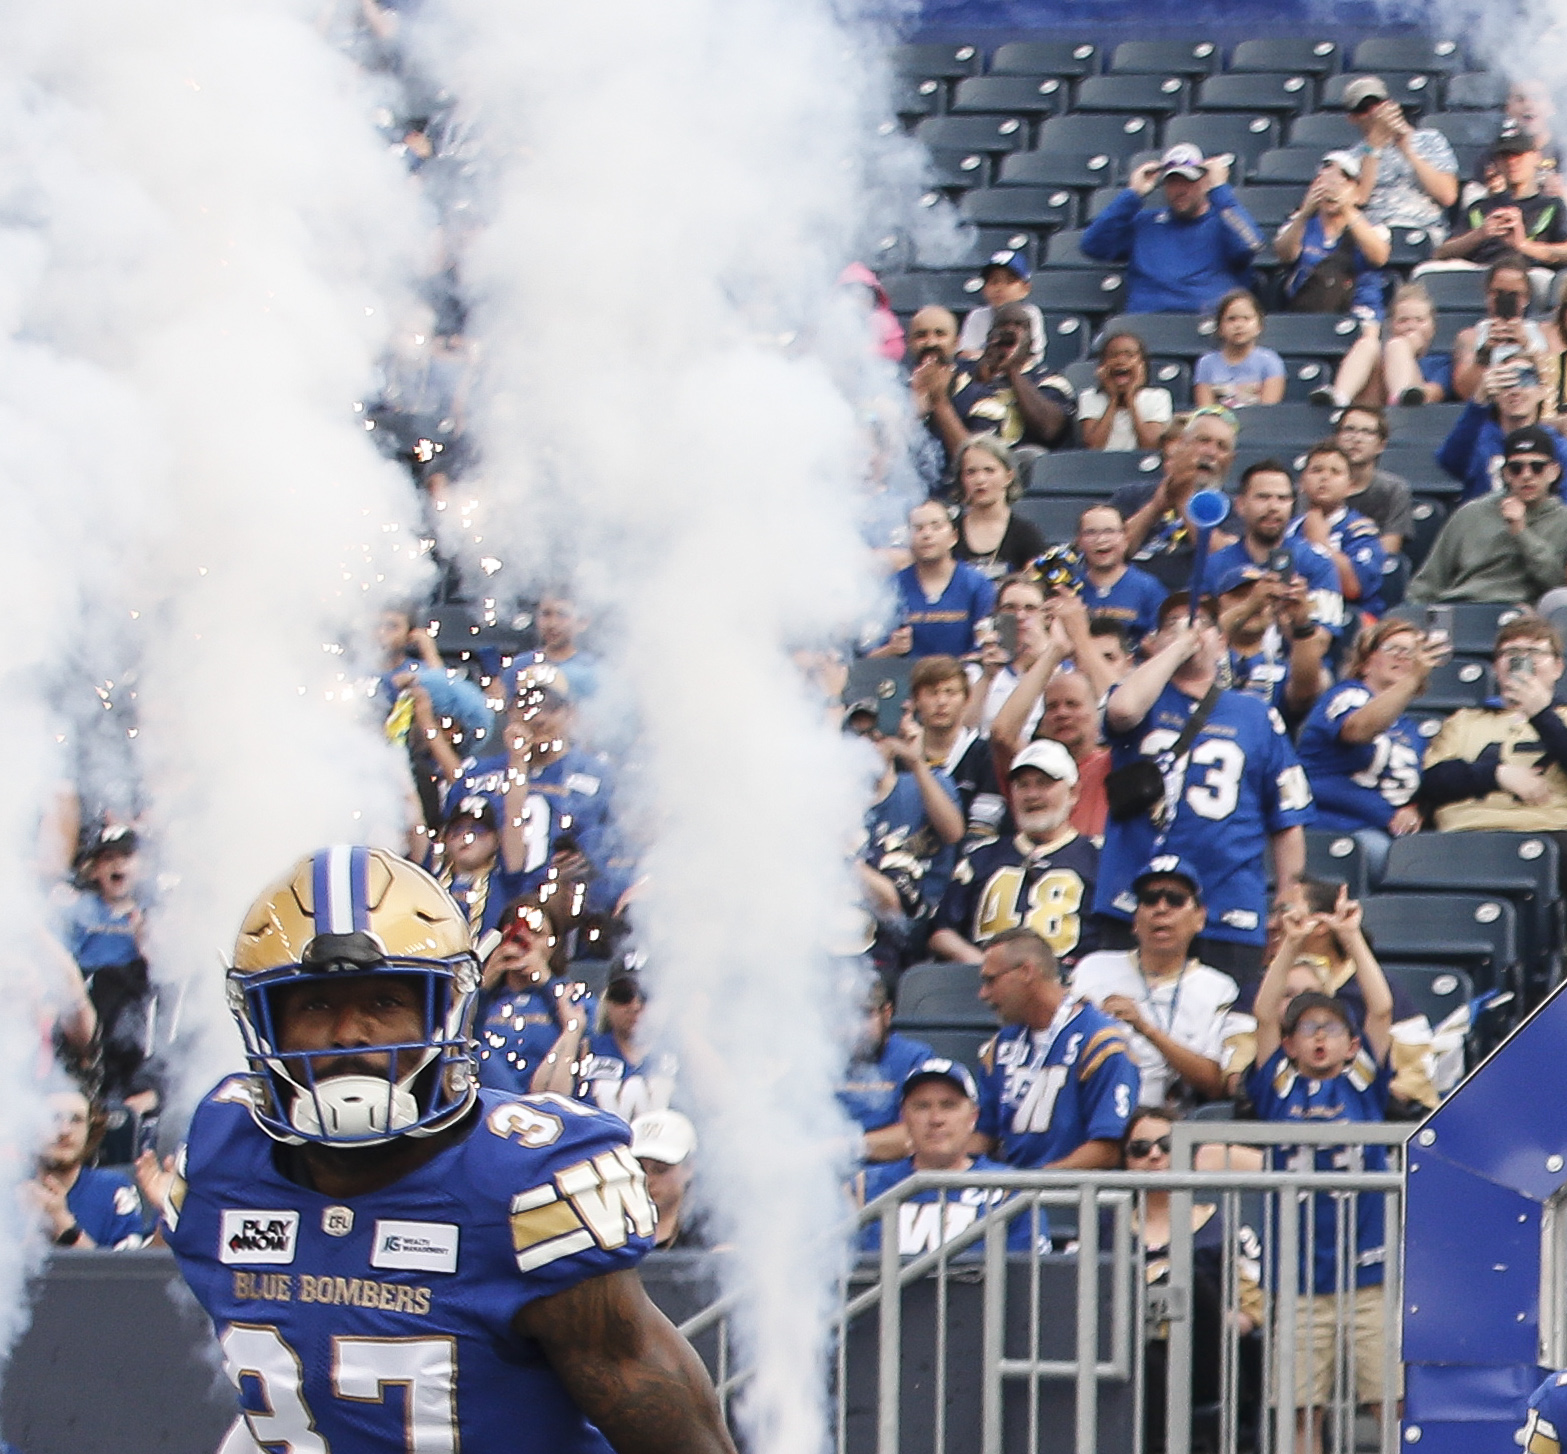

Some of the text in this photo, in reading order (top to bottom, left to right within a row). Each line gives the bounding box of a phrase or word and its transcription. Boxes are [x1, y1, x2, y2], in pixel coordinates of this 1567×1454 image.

[973, 865, 1085, 957] 48
[232, 1270, 433, 1317] BLUE BOMBERS
